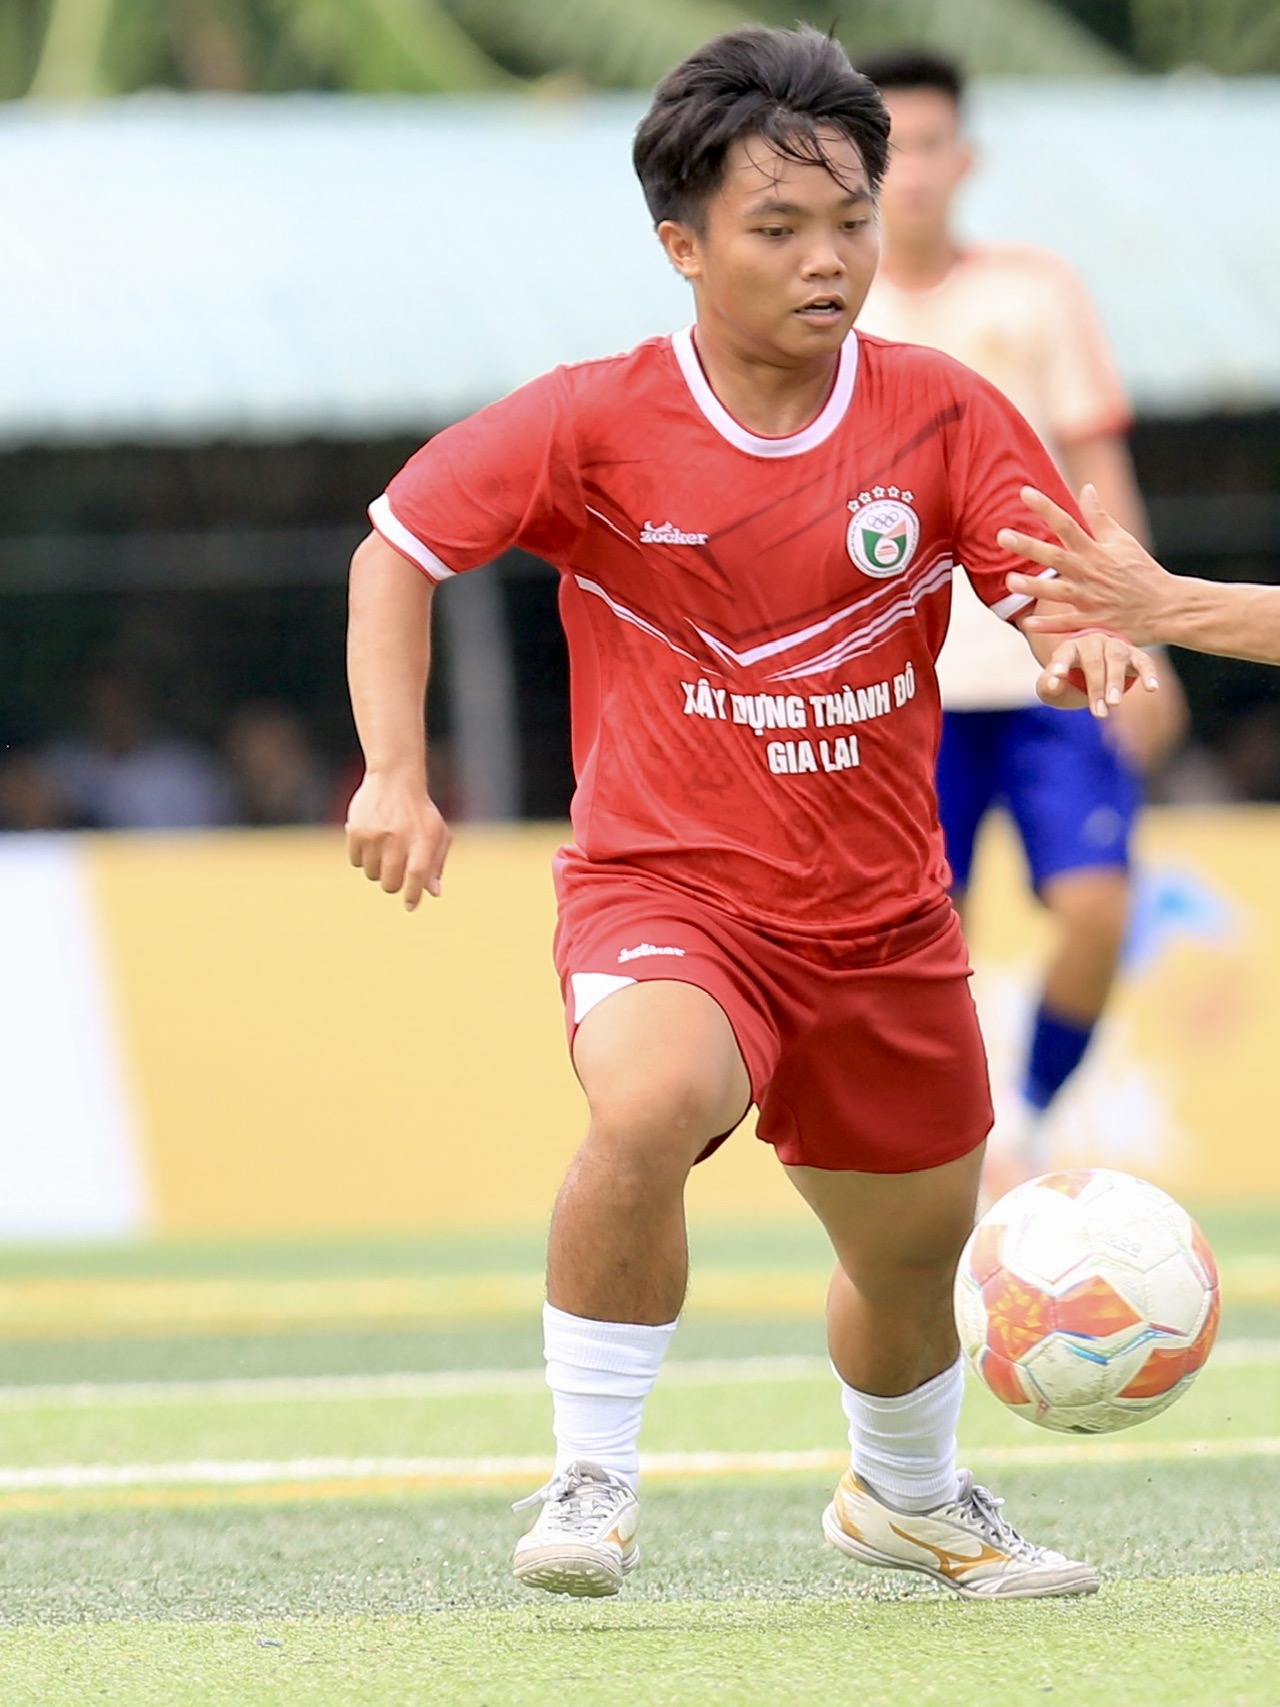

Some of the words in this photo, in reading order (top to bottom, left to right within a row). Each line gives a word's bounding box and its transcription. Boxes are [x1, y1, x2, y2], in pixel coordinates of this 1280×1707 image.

[681, 678, 728, 720] XÂY
[731, 693, 807, 736] DỰNG
[809, 685, 892, 728] THÀNH
[893, 661, 917, 708] ĐÔ
[767, 741, 818, 774] GIA
[819, 735, 861, 772] LAI
